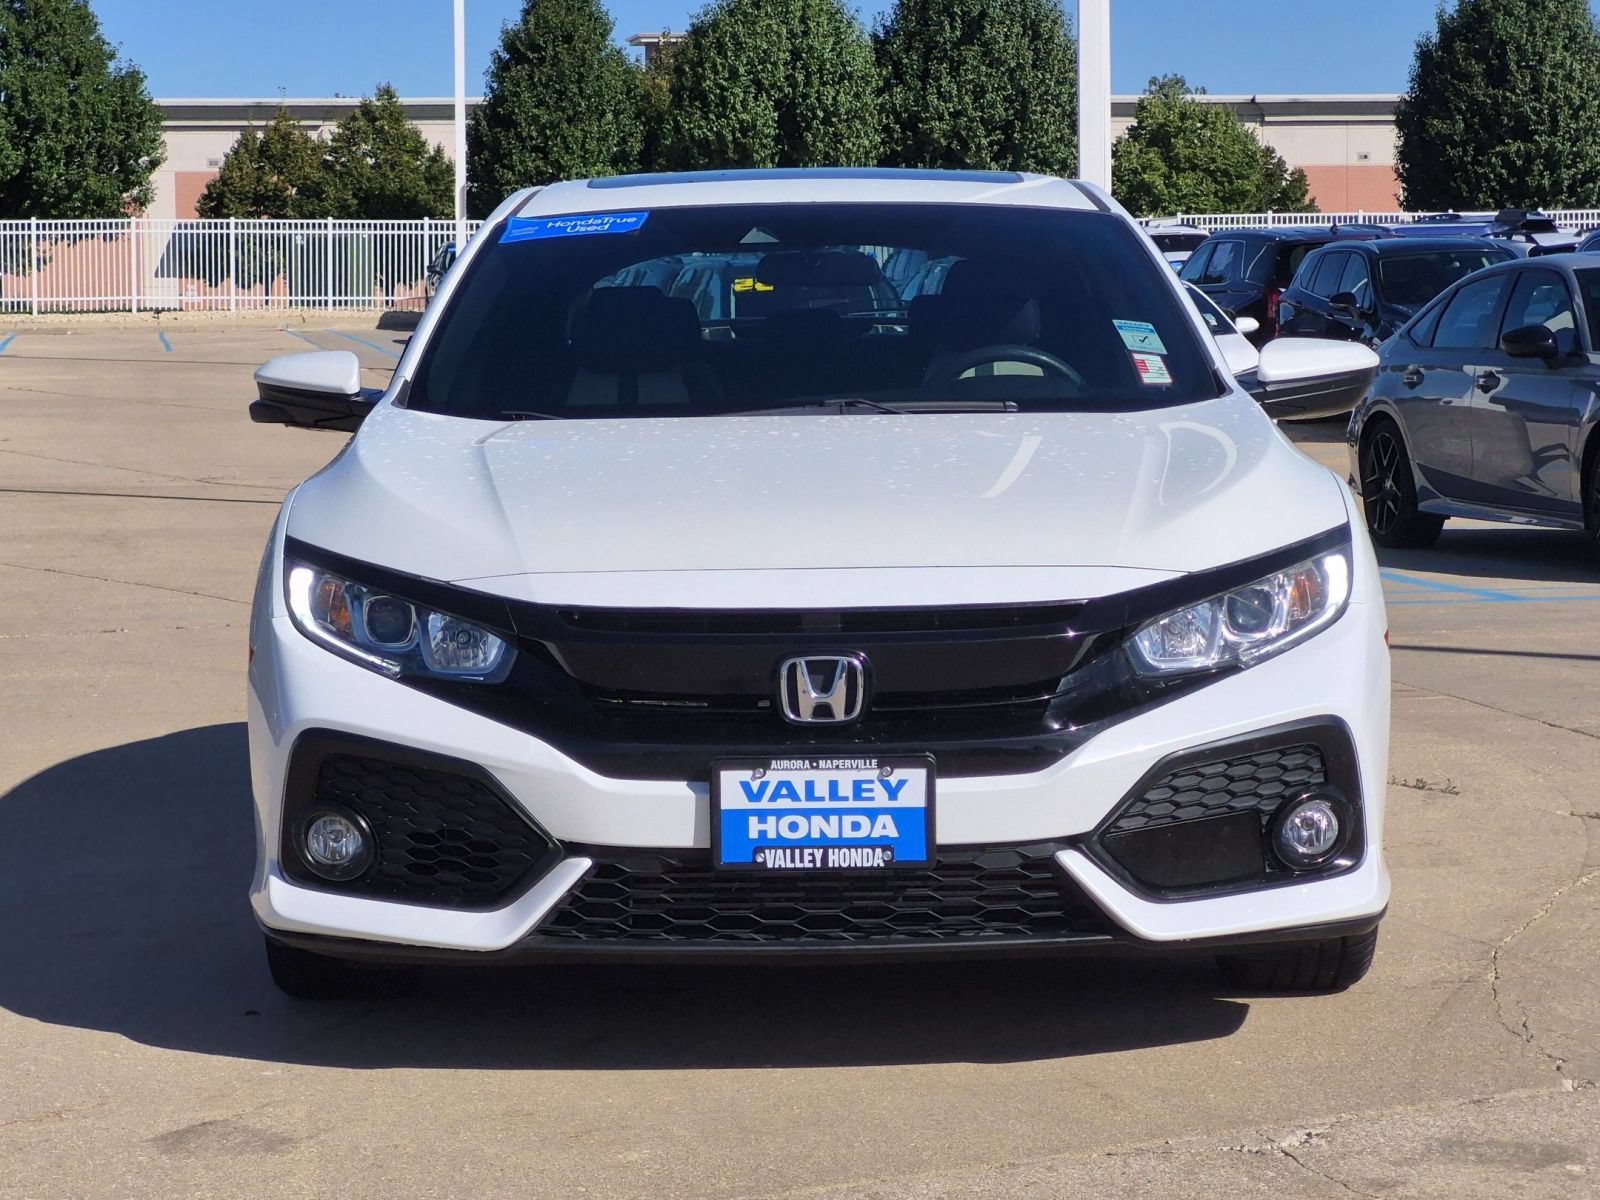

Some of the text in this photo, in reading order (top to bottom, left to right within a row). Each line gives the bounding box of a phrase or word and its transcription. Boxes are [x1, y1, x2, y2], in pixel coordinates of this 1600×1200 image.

[547, 216, 637, 229] HondaTrue
[566, 223, 610, 233] Used
[770, 759, 878, 770] AURORA NAPERVILLE
[739, 779, 908, 802] VALLEY
[748, 814, 900, 839] HONDA
[764, 847, 885, 868] VALLEY HONDA
